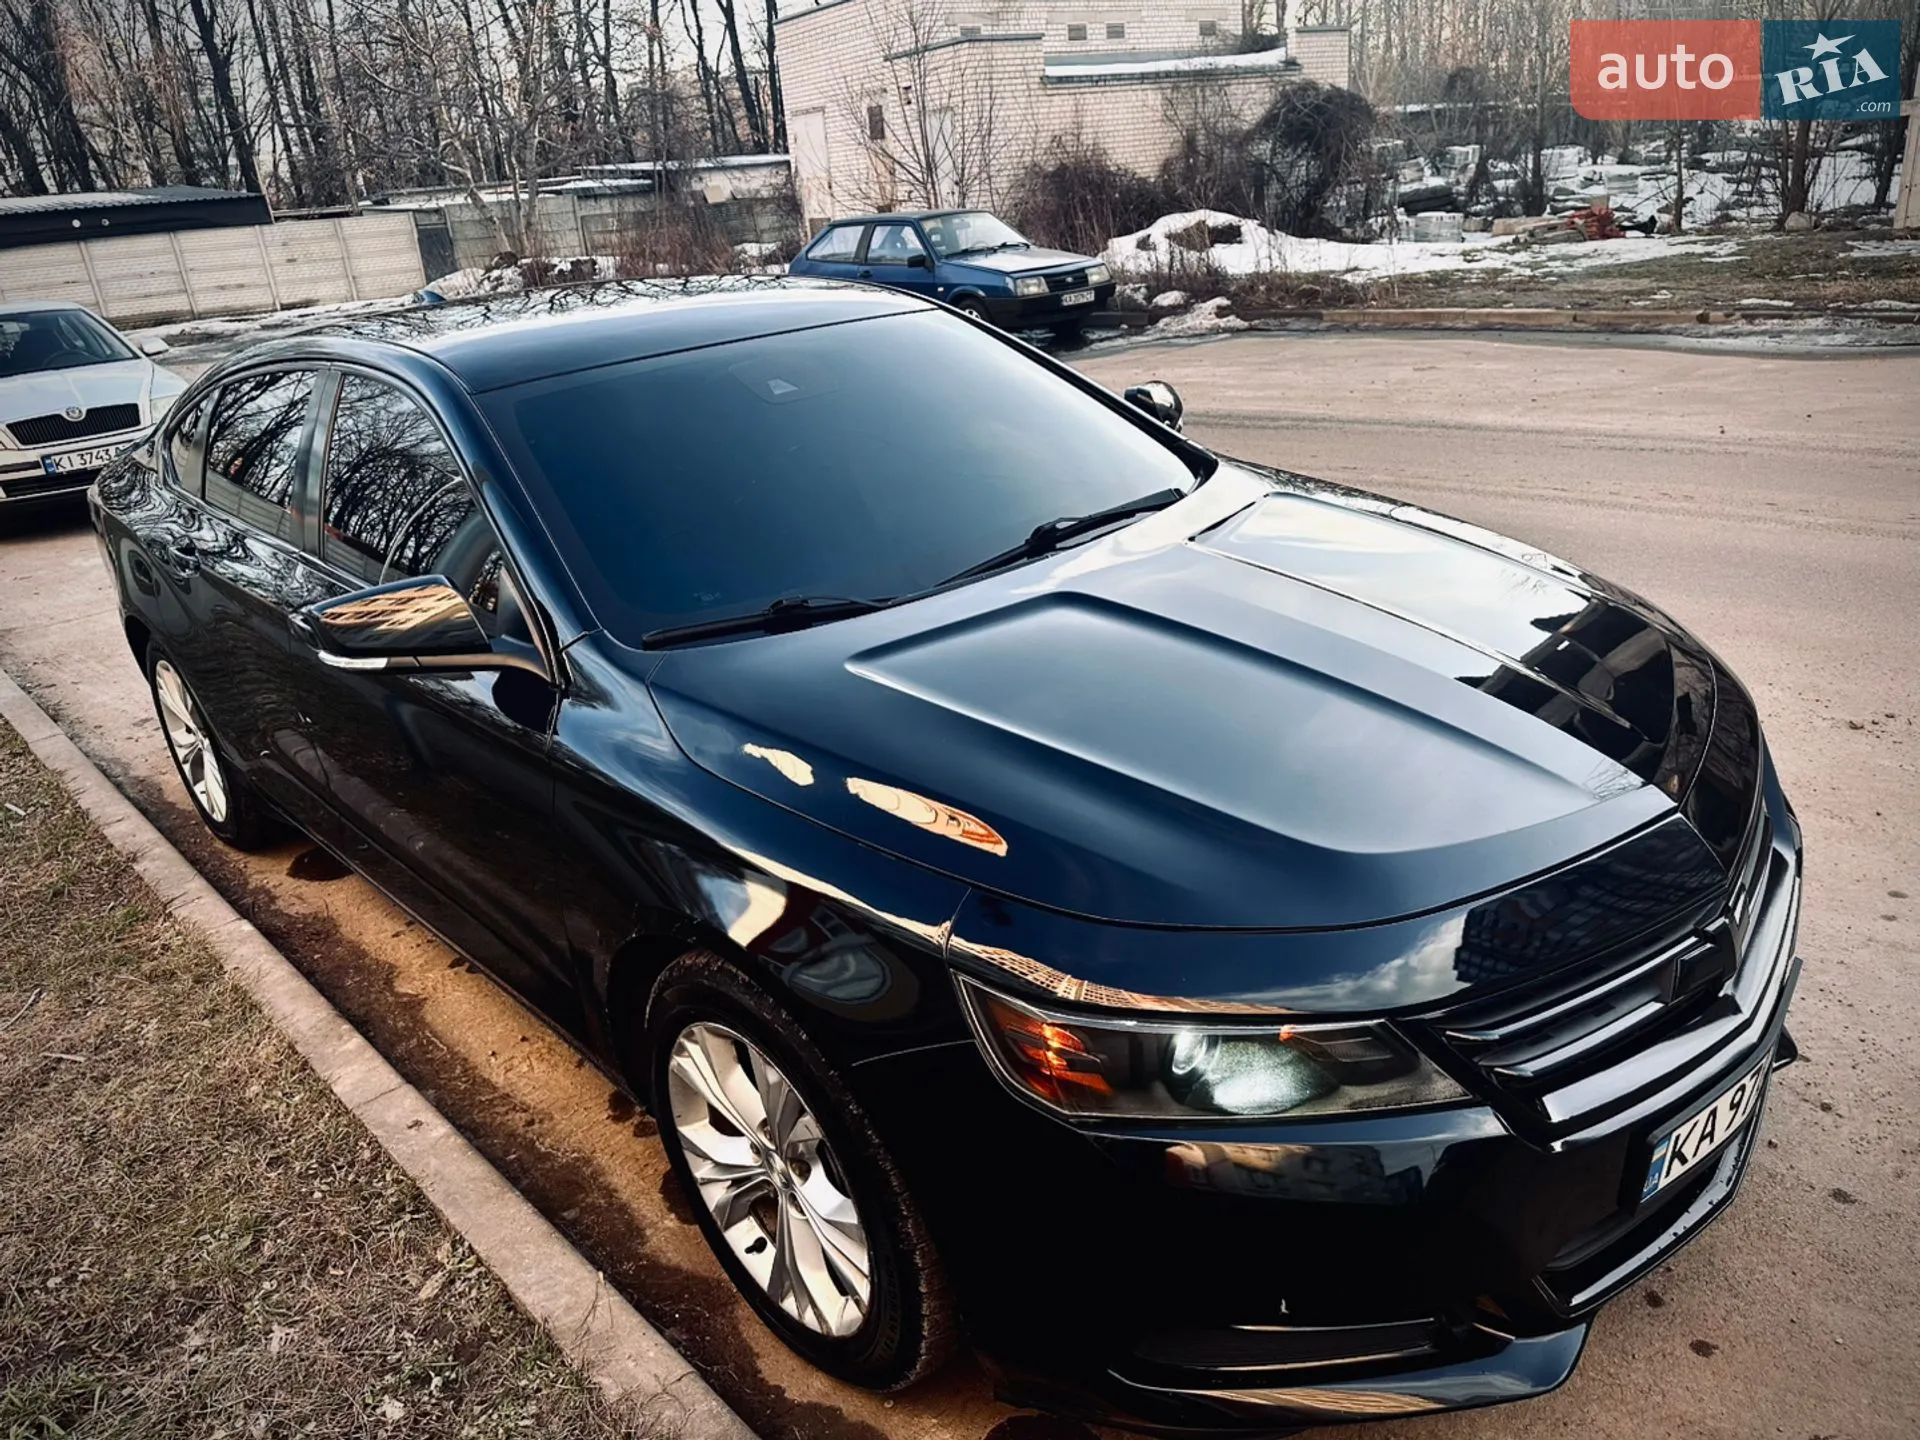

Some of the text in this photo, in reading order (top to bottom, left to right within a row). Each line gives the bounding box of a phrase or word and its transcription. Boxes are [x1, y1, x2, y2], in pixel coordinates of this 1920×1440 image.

[53, 455, 74, 471] KI
[77, 448, 112, 466] 3743
[1664, 1062, 1764, 1179] KA 97
